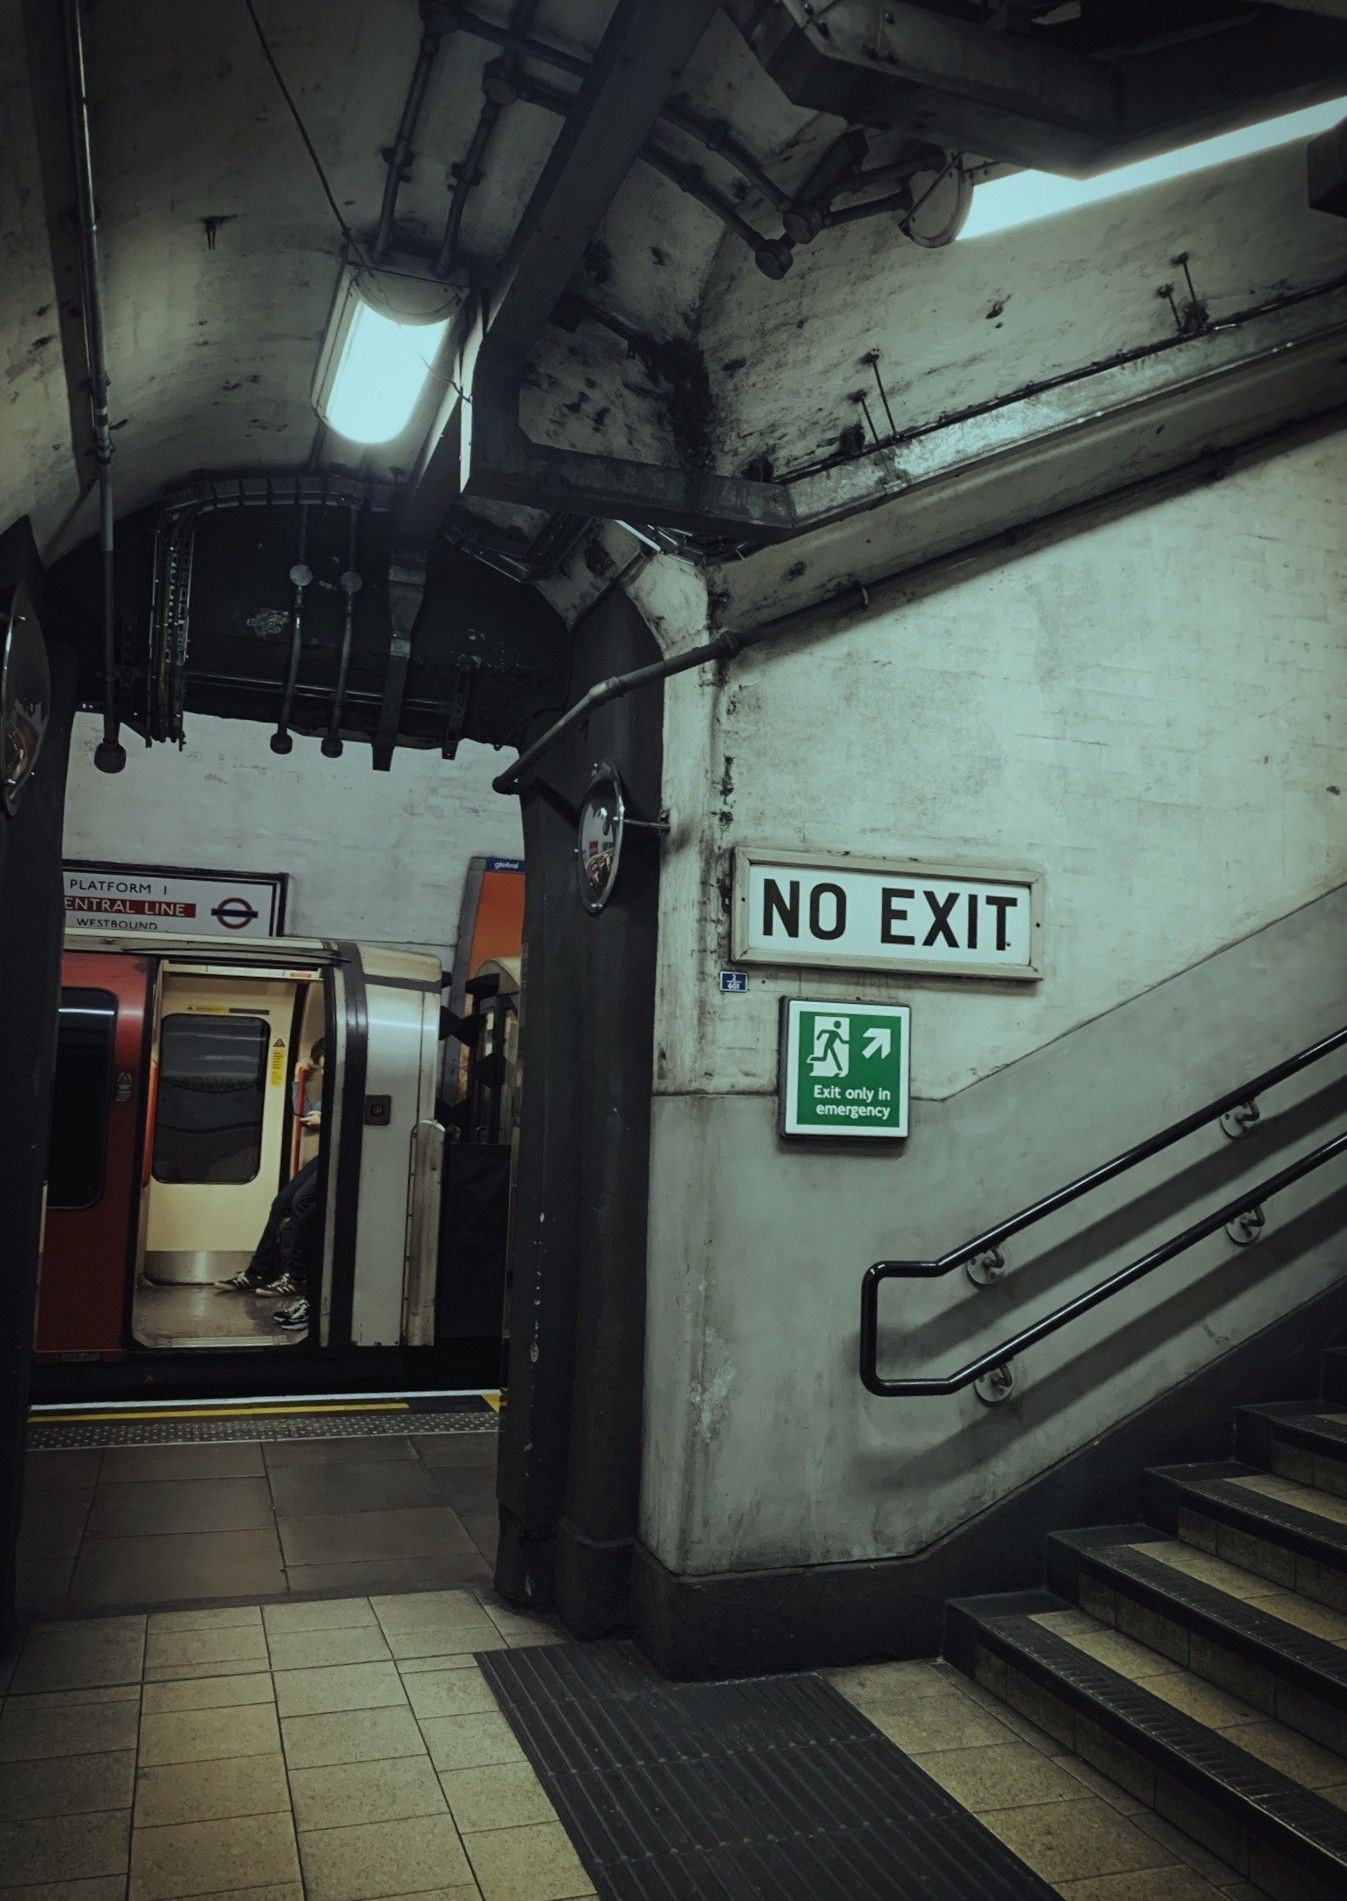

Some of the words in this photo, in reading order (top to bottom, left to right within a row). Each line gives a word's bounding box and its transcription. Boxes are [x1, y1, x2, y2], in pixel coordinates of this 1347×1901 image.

[70, 879, 151, 894] PLATFORM
[64, 897, 136, 913] ENTRAL
[144, 903, 186, 916] LINE
[763, 879, 847, 940] NO
[880, 888, 1018, 951] EXIT
[76, 918, 158, 931] WESTBOUND
[813, 1085, 841, 1098] Exit
[845, 1087, 874, 1103] only
[879, 1087, 891, 1100] in
[816, 1104, 890, 1120] emergency
